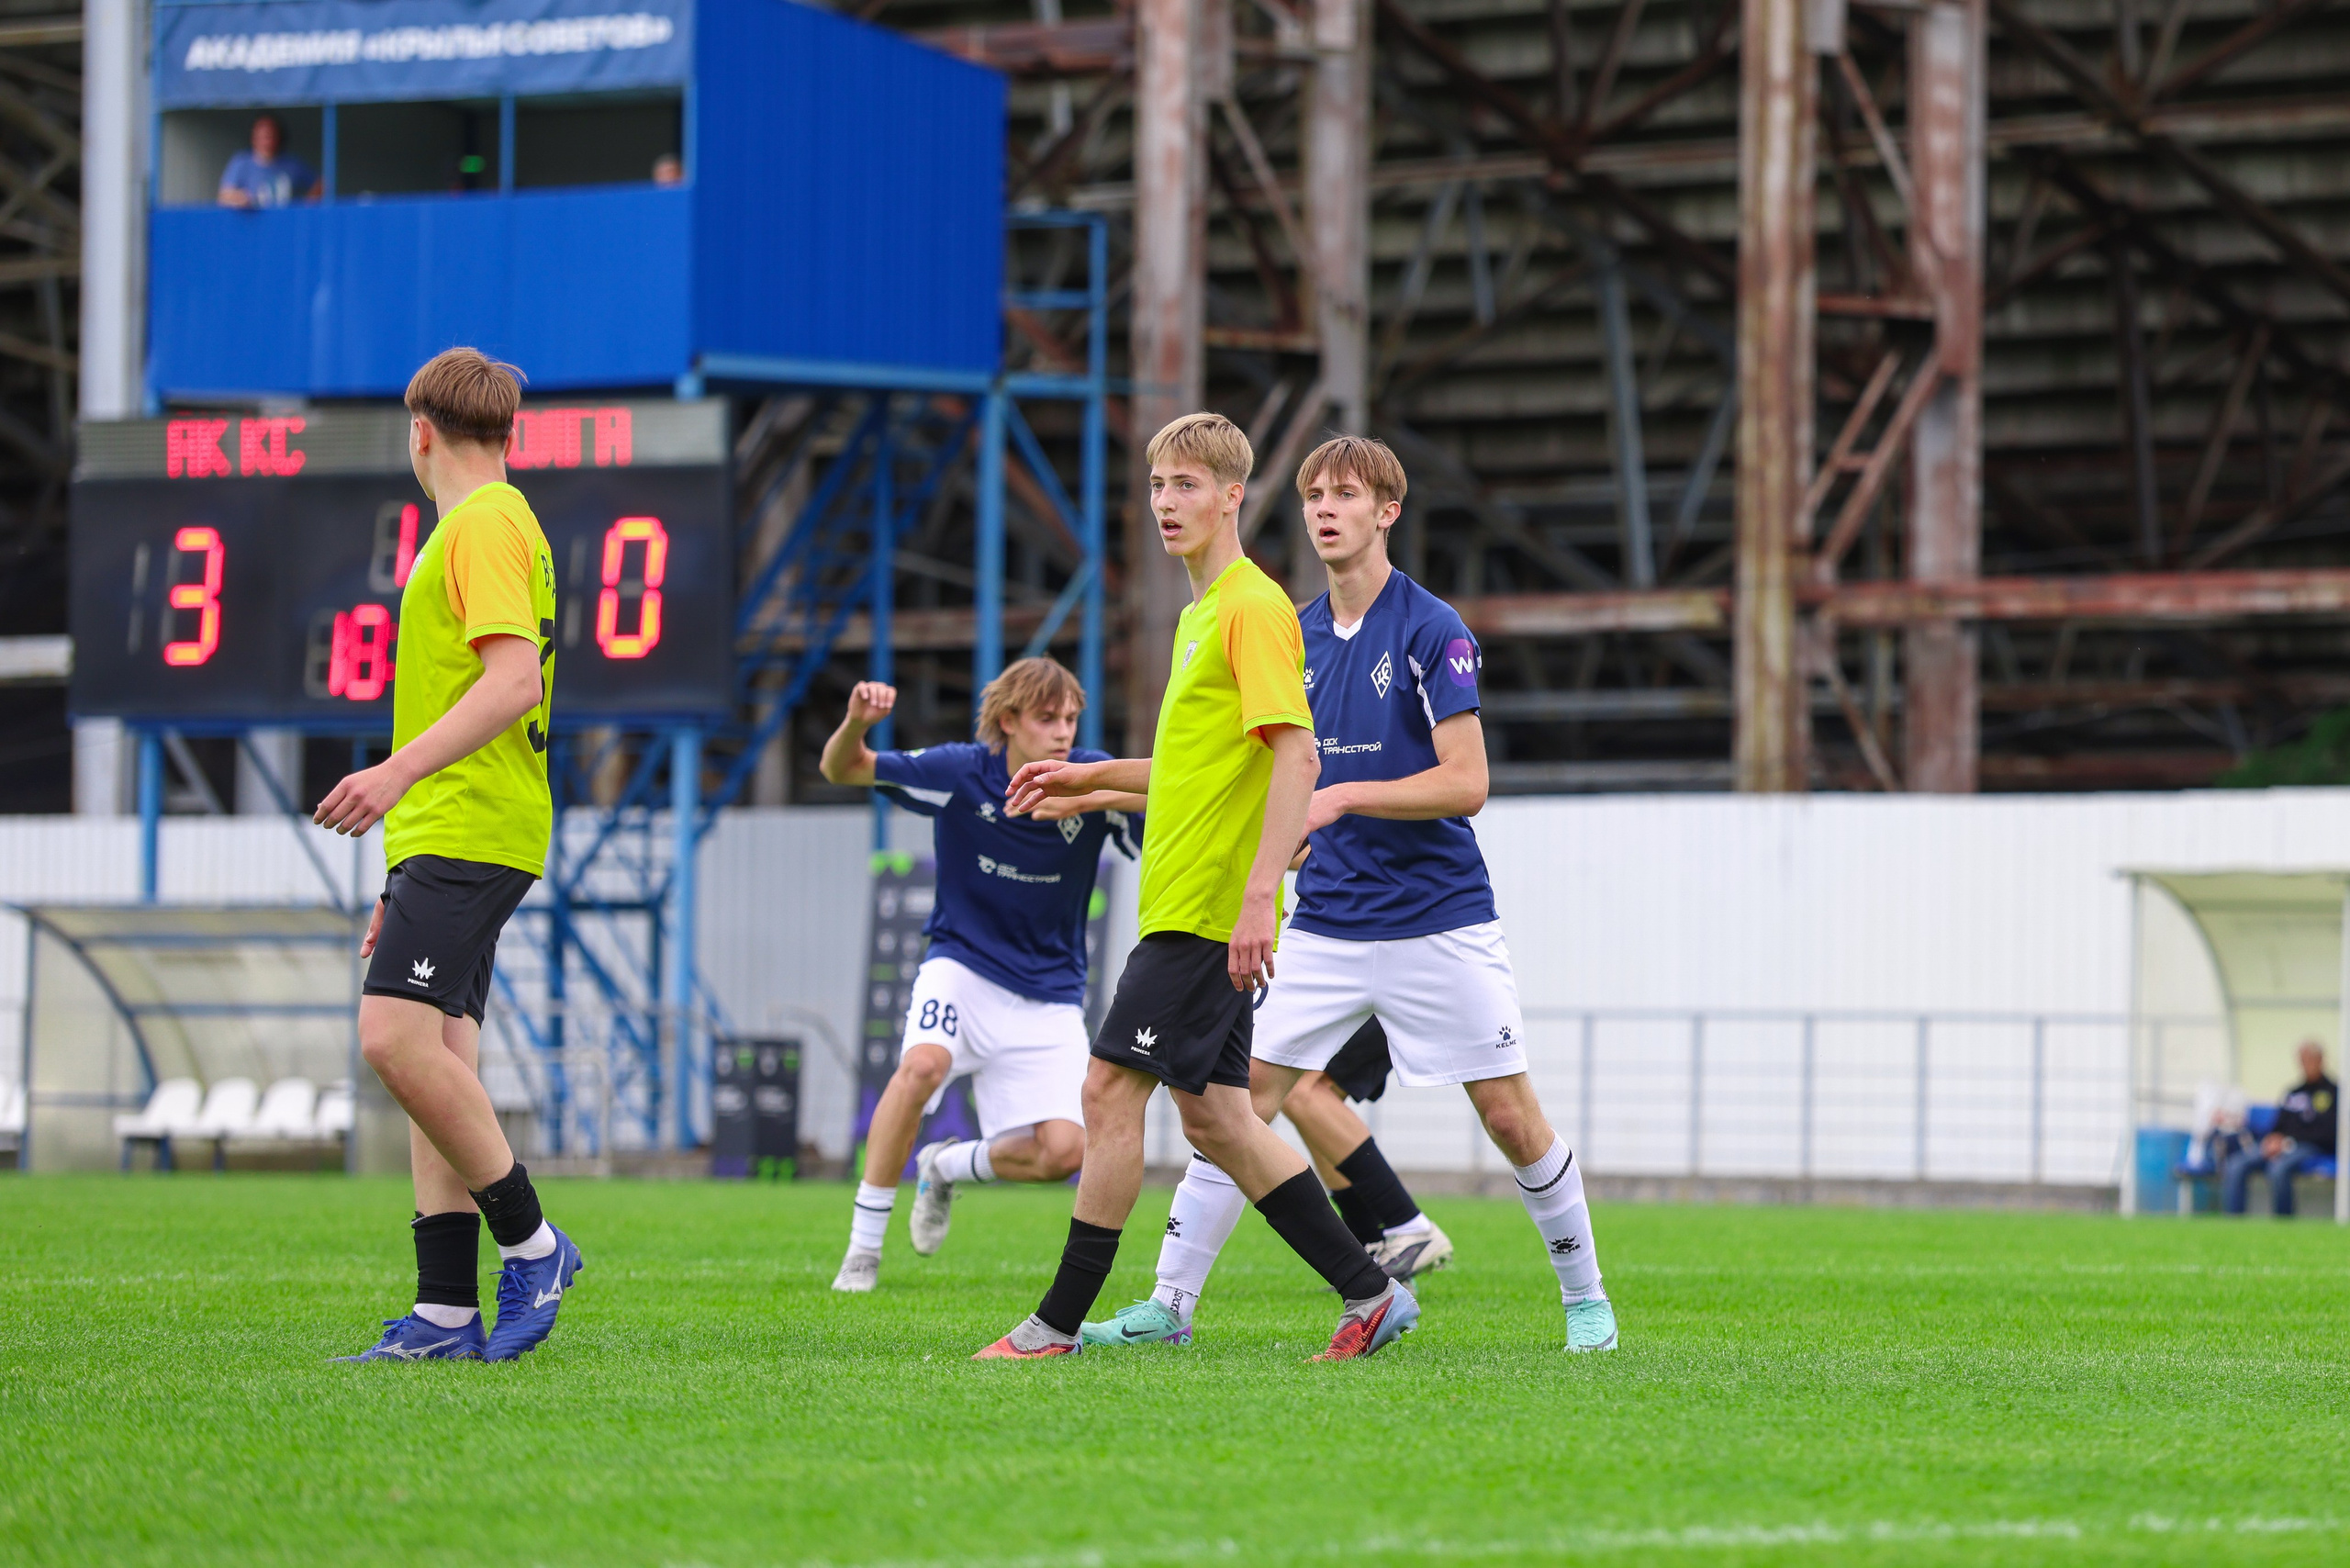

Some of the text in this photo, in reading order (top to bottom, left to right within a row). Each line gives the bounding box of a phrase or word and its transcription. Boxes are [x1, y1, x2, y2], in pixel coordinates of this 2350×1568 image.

[167, 416, 307, 478] АК КС
[506, 407, 632, 470] ОЛГА
[163, 527, 225, 666] 3
[596, 517, 669, 659] 0
[1323, 737, 1338, 747] ДСК
[1323, 741, 1382, 756] ТРАНССТРОЙ
[920, 999, 957, 1036] 88
[1495, 1039, 1517, 1049] KELME
